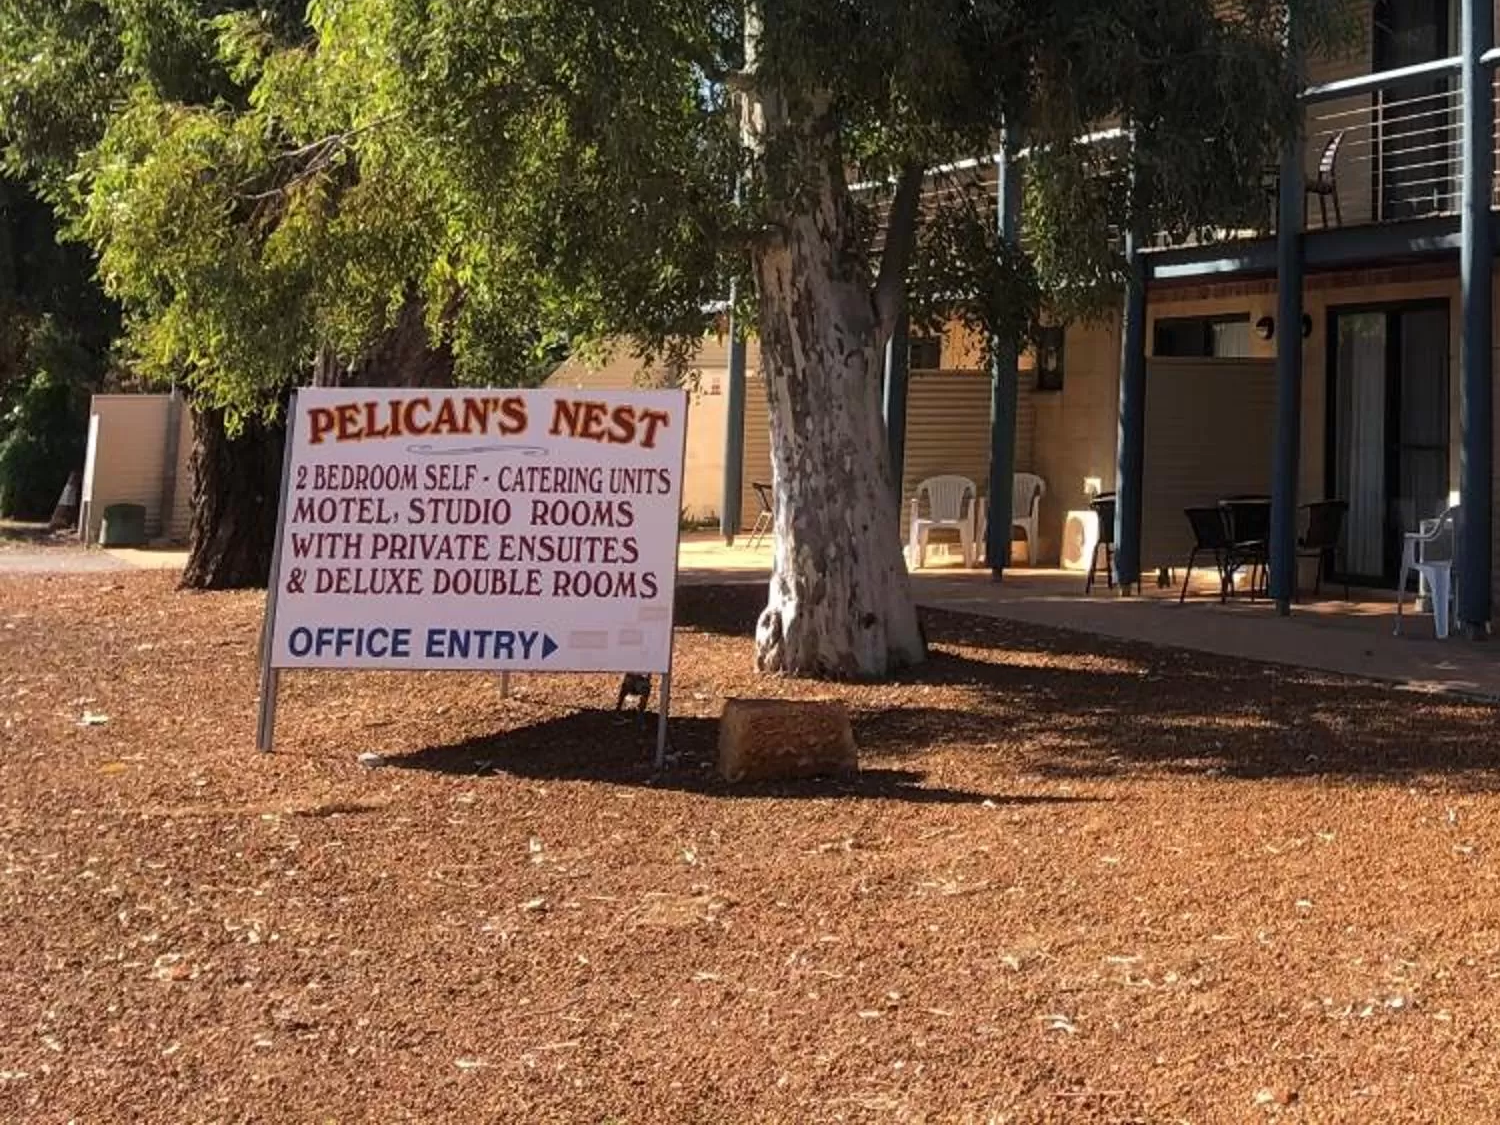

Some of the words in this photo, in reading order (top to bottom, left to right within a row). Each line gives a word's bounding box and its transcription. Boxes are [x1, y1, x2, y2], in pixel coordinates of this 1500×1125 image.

[307, 395, 529, 444] PELICAN'S
[549, 399, 670, 448] NEST
[295, 465, 307, 490] 2
[313, 465, 417, 491] BEDROOM
[423, 465, 478, 491] SELF
[498, 467, 603, 493] CATERING
[609, 468, 671, 494] UNITS
[292, 498, 399, 524] MOTEL,
[407, 499, 511, 525] STUDIO
[530, 500, 633, 527] ROOMS
[291, 533, 362, 559] WITH
[371, 534, 488, 561] PRIVATE
[500, 536, 638, 563] ENSUITES
[286, 569, 304, 594] &
[313, 569, 423, 595] DELUXE
[433, 569, 542, 596] DOUBLE
[552, 571, 657, 598] ROOMS
[288, 627, 411, 657] OFFICE
[425, 628, 538, 659] ENTRY
